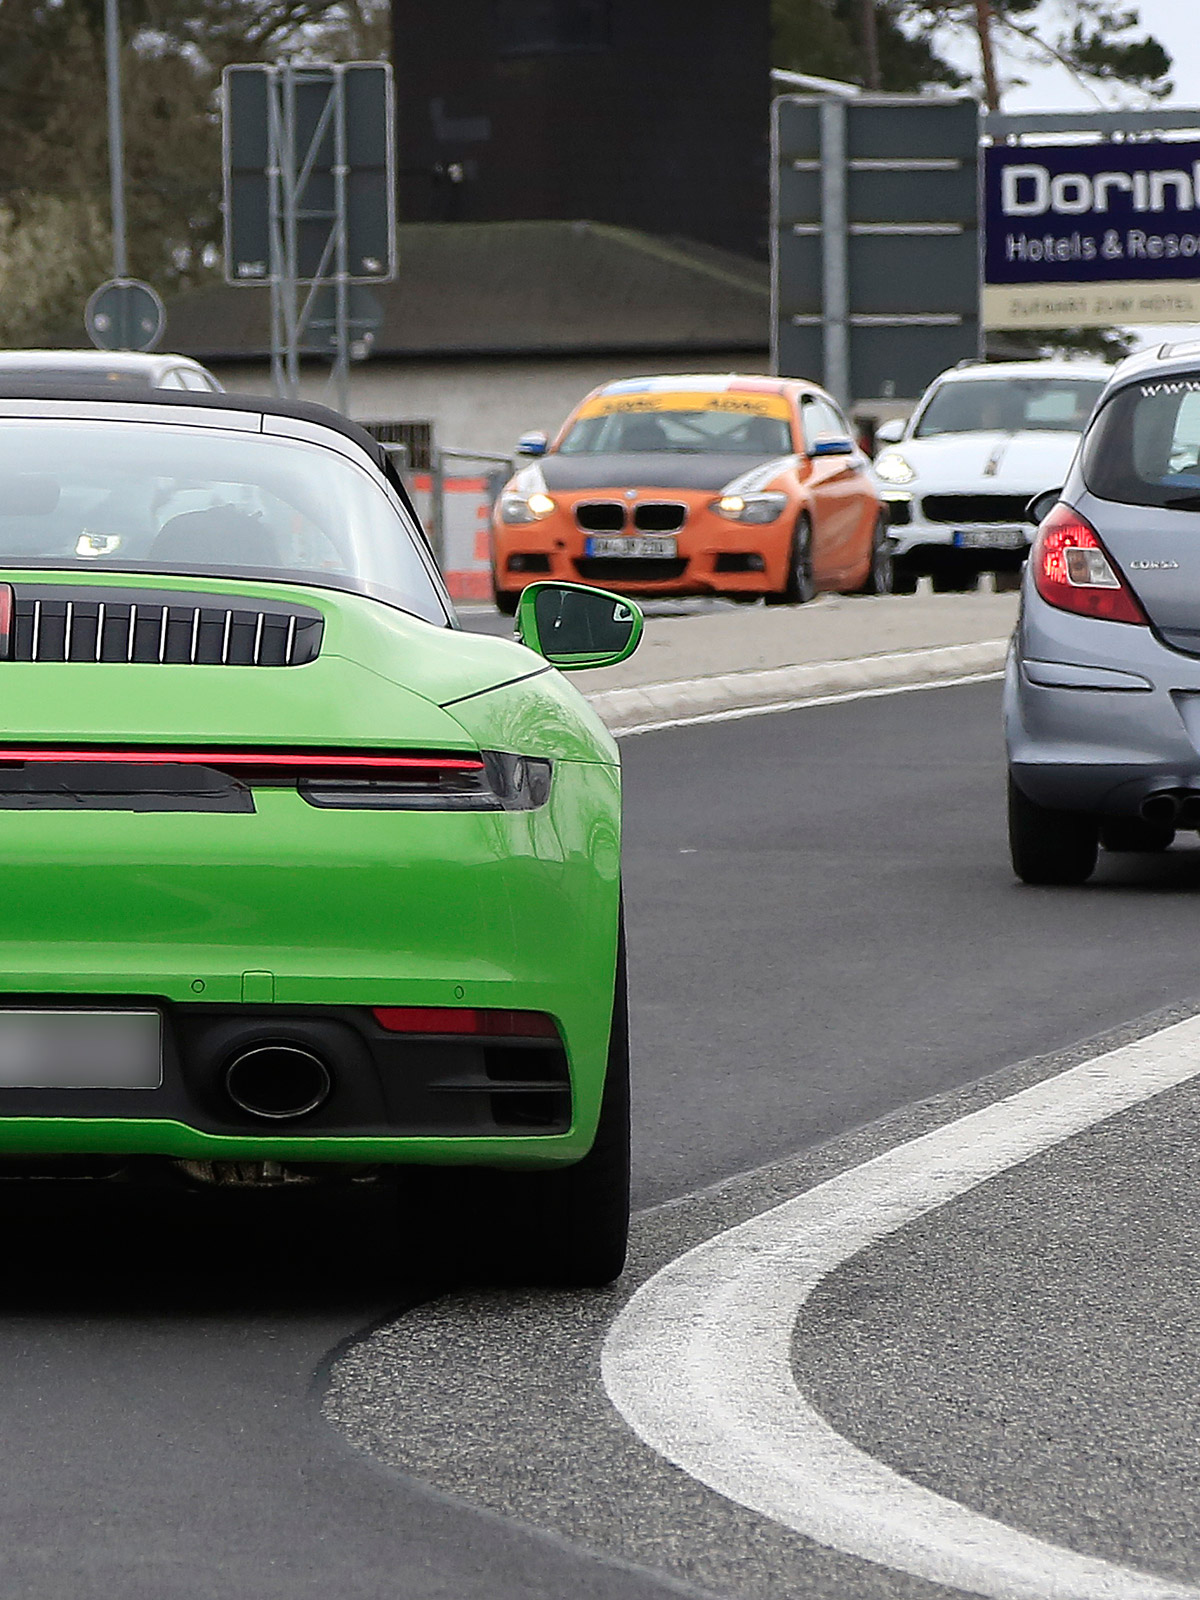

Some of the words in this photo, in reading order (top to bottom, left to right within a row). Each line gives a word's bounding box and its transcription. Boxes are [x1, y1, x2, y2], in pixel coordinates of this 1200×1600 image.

[1005, 231, 1097, 262] Hotels
[1102, 229, 1124, 259] &
[1127, 229, 1200, 259] Reso
[1129, 559, 1179, 569] CORSA
